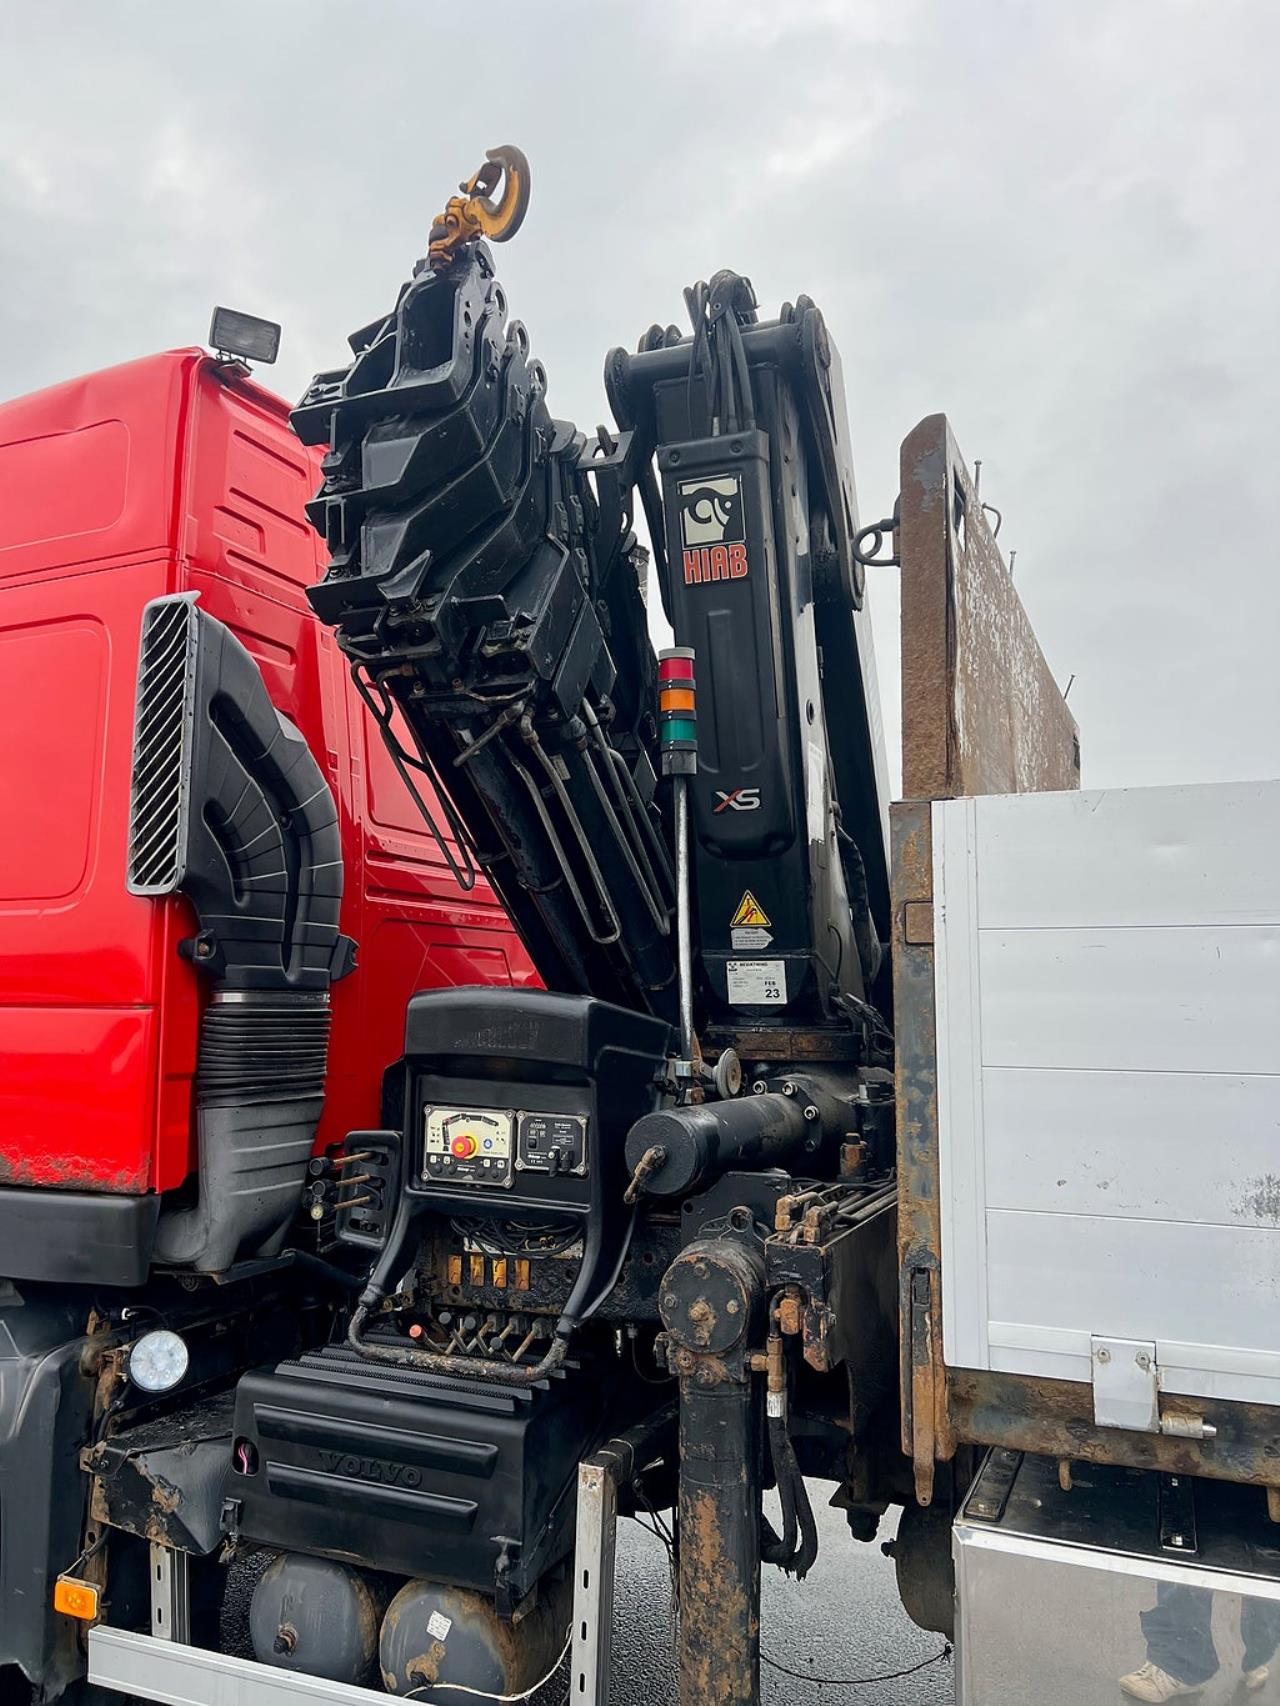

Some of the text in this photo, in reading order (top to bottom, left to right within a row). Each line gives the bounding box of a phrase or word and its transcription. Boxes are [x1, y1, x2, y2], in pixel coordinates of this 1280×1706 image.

[683, 543, 748, 585] HIAB
[713, 788, 760, 813] XS
[765, 988, 781, 998] 23
[319, 1450, 422, 1488] VOLVO
